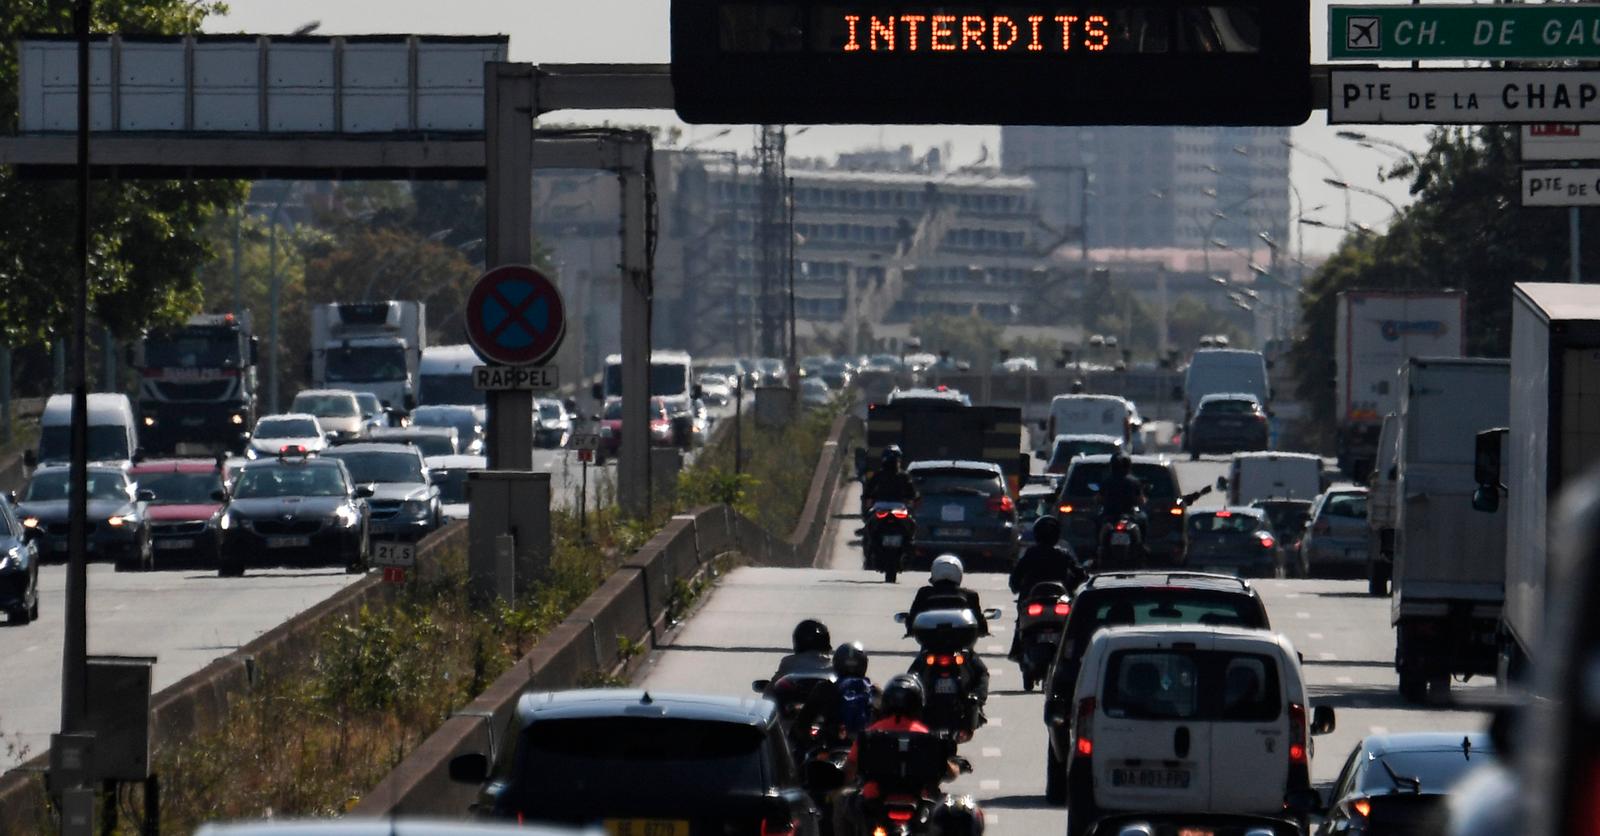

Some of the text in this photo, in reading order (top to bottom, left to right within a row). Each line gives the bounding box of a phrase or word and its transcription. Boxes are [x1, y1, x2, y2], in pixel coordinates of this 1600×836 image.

[844, 15, 1109, 50] INTERDITS
[1394, 20, 1447, 46] CH.
[1473, 20, 1516, 46] DE
[1408, 93, 1436, 109] DE
[1454, 93, 1479, 109] LA
[1502, 84, 1597, 109] CHAP
[1568, 184, 1588, 196] DE
[477, 369, 552, 387] RAPPEL
[379, 546, 411, 559] 21.5
